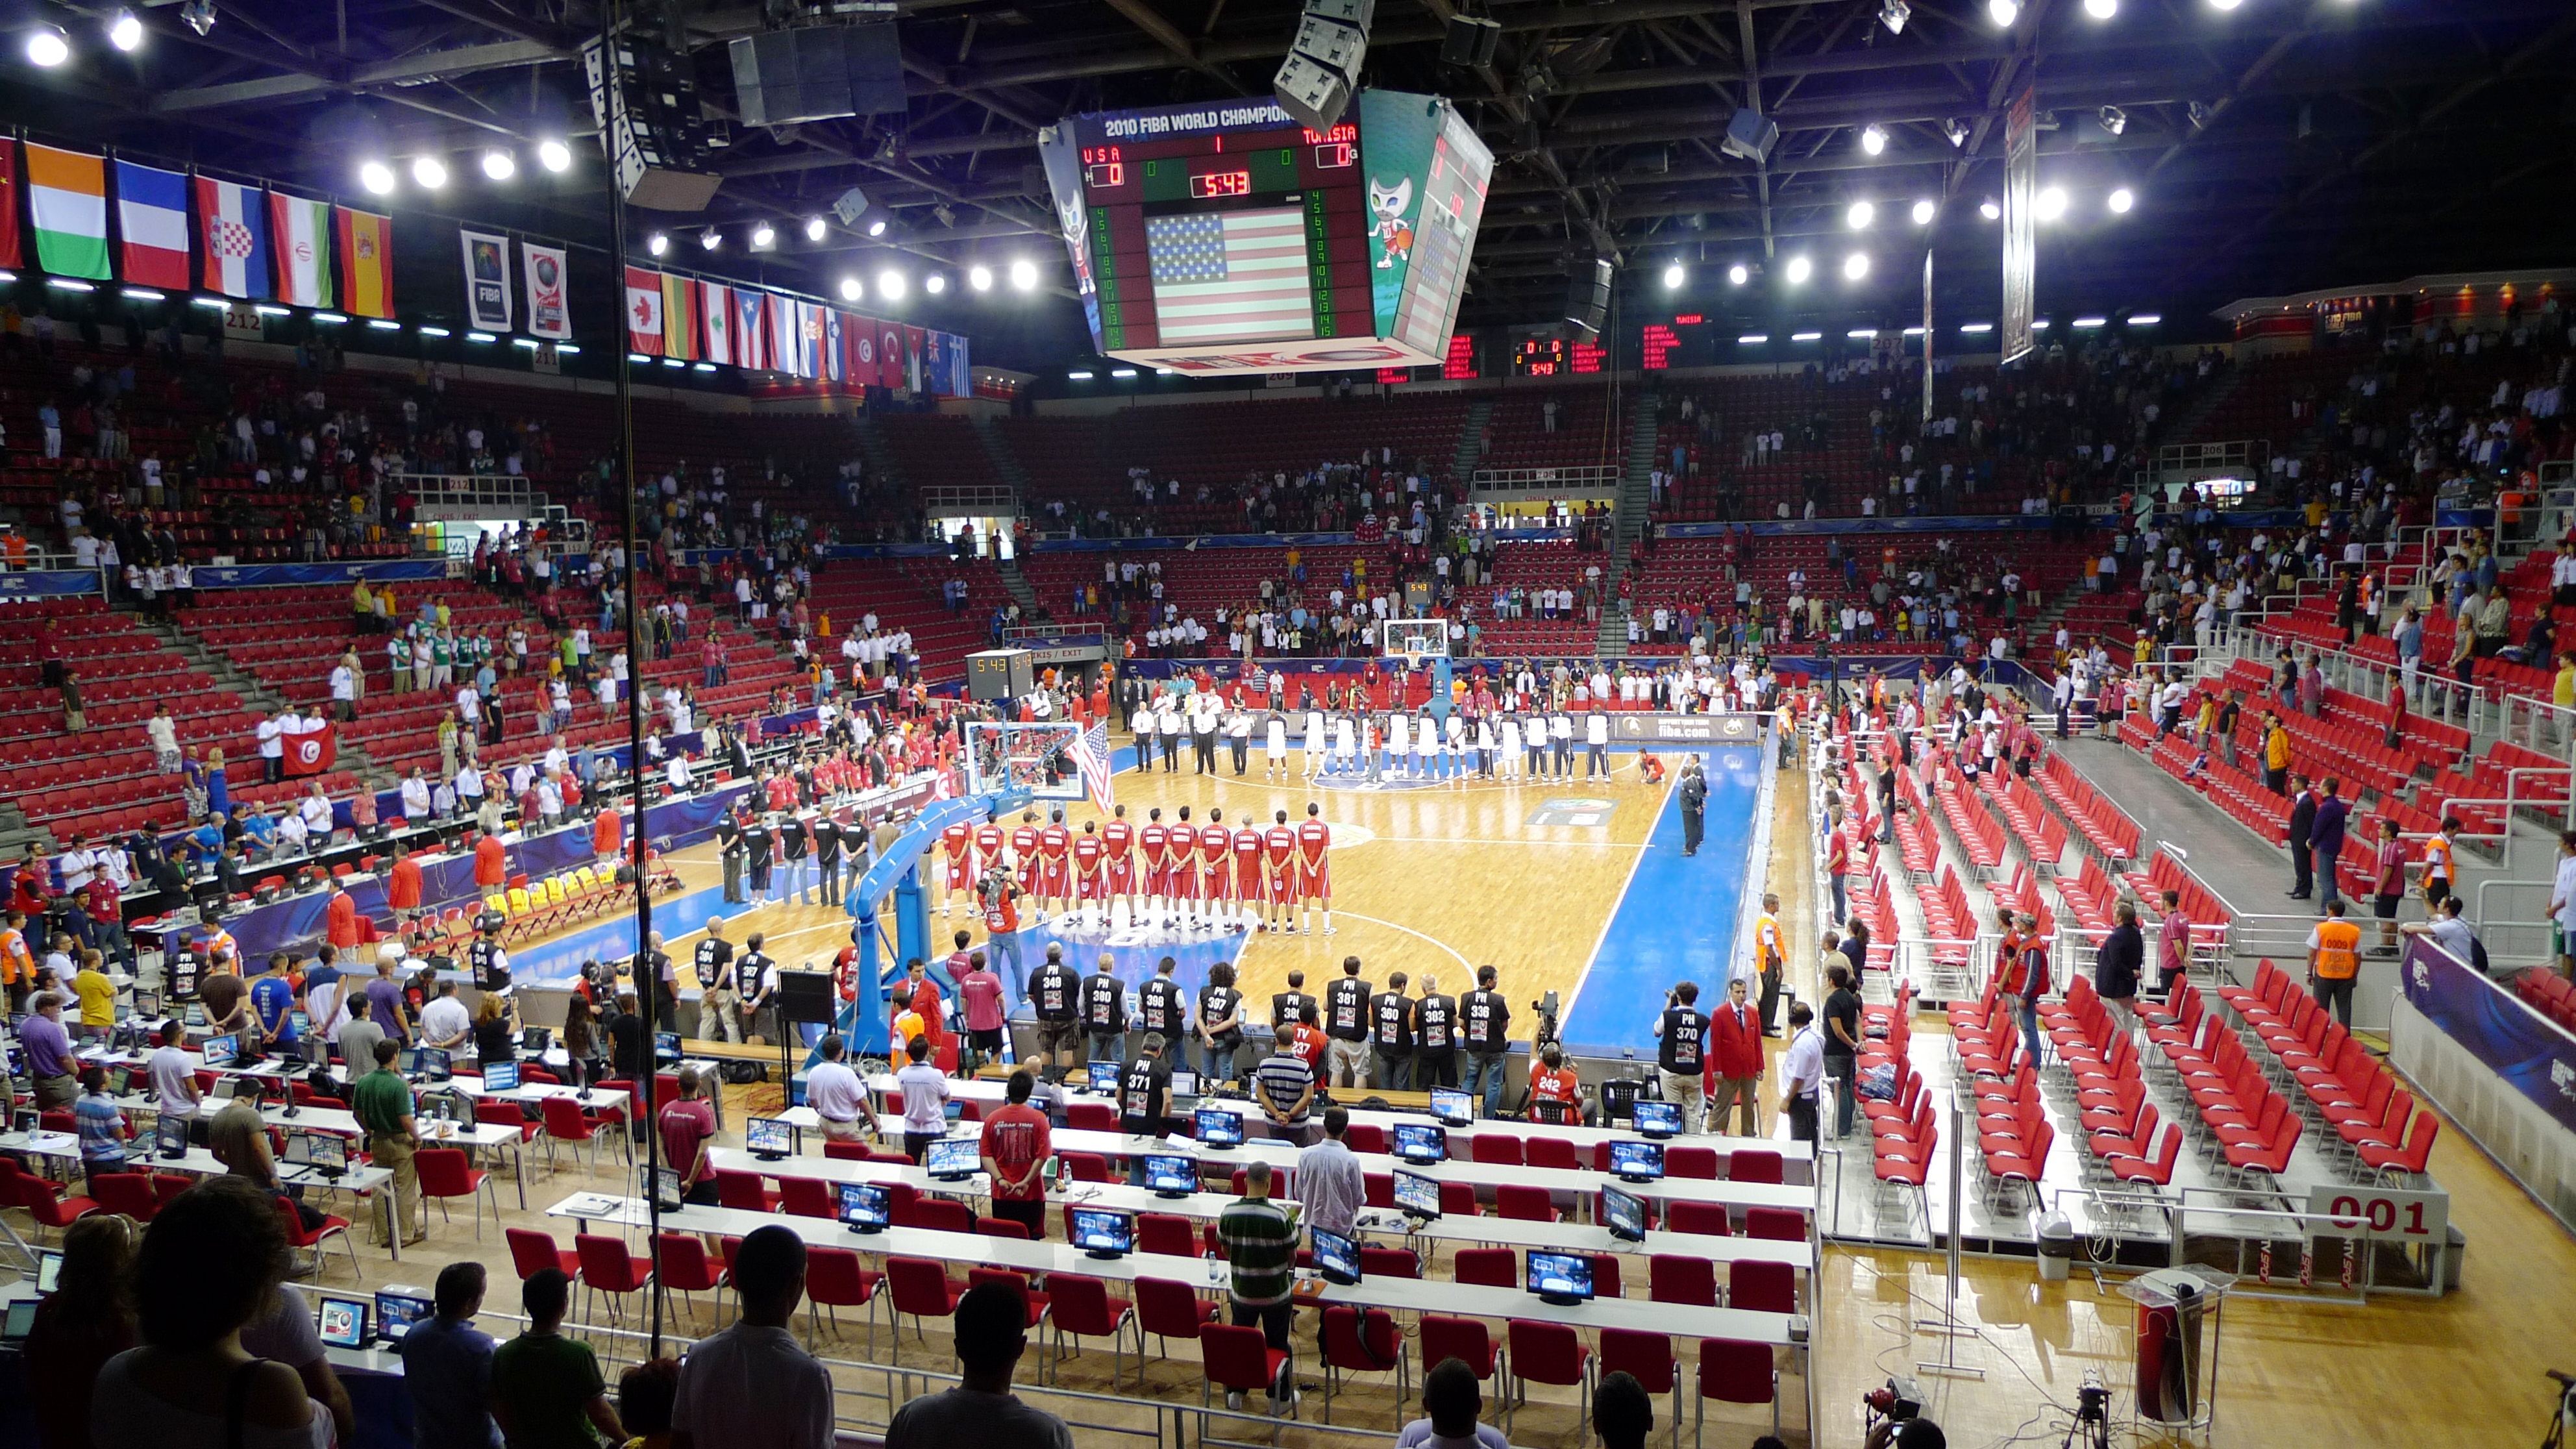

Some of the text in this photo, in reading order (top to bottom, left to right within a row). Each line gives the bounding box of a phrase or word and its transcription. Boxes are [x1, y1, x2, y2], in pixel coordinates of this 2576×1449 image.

[1106, 118, 1137, 137] 2010
[1140, 115, 1170, 134] FIBA
[1170, 110, 1219, 132] WORLD
[1282, 149, 1290, 166] 0
[1337, 144, 1350, 166] 0
[1350, 149, 1358, 160] G
[1147, 161, 1156, 177] 0
[1085, 172, 1095, 182] H
[1109, 164, 1122, 186] 0
[1205, 173, 1248, 197] 5:43
[1313, 190, 1319, 201] 4
[1097, 208, 1104, 217] 4
[1313, 203, 1320, 214] 5
[1099, 220, 1105, 230] 5
[1315, 216, 1322, 227] 6
[1100, 232, 1107, 242] 6
[1317, 227, 1322, 238] 7
[1102, 243, 1108, 253] 7
[1317, 241, 1324, 251] 8
[1104, 256, 1109, 266] 8
[1318, 253, 1324, 263] 9
[1105, 267, 1111, 277] 9
[1317, 266, 1326, 276] 10
[1104, 279, 1113, 290] 10
[1317, 278, 1327, 287] 11
[480, 287, 501, 303] FIBA
[1106, 291, 1114, 301] 11
[1319, 290, 1328, 301] 12
[1107, 303, 1115, 314] 12
[1320, 303, 1328, 312] 13
[226, 312, 261, 331] 212
[1109, 315, 1117, 326] 13
[1320, 316, 1330, 325] 14
[1110, 326, 1119, 336] 14
[1322, 327, 1331, 336] 15
[1111, 338, 1120, 349] 15
[1527, 342, 1534, 354] 0
[1552, 340, 1559, 352] 0
[1873, 338, 1902, 351] 207
[535, 352, 558, 365] 211
[1531, 363, 1554, 375] 5:43
[2203, 445, 2222, 454] 206
[450, 479, 469, 489] 212
[446, 564, 464, 573] 113
[1032, 651, 1052, 660] IKIŞ
[991, 658, 1006, 671] 43
[1658, 725, 1710, 737] fiba.com
[477, 943, 486, 953] PH
[704, 939, 715, 950] PH
[180, 953, 192, 962] PH
[747, 954, 758, 965] PH
[177, 963, 196, 974] 350
[1047, 965, 1059, 976] PH
[1043, 976, 1062, 989] 349
[1097, 977, 1109, 988] PH
[1152, 982, 1164, 993] PH
[1343, 979, 1356, 991] PH
[1214, 985, 1228, 997] PH
[1146, 995, 1165, 1008] 398
[1287, 995, 1300, 1006] PH
[1337, 993, 1356, 1005] 381
[1384, 995, 1397, 1006] PH
[1475, 991, 1487, 1003] PH
[1208, 997, 1228, 1010] 397
[1428, 998, 1440, 1009] PH
[1380, 1008, 1399, 1021] 360
[1426, 1010, 1445, 1022] 382
[1470, 1005, 1490, 1018] 336
[1682, 1013, 1695, 1025] PH
[1296, 1027, 1310, 1039] TV
[1676, 1027, 1698, 1041] 370
[1135, 1059, 1151, 1072] PH
[1128, 1074, 1150, 1091] 371
[1539, 1076, 1561, 1093] 242
[666, 1109, 696, 1119] Champion
[2329, 1195, 2429, 1235] 001
